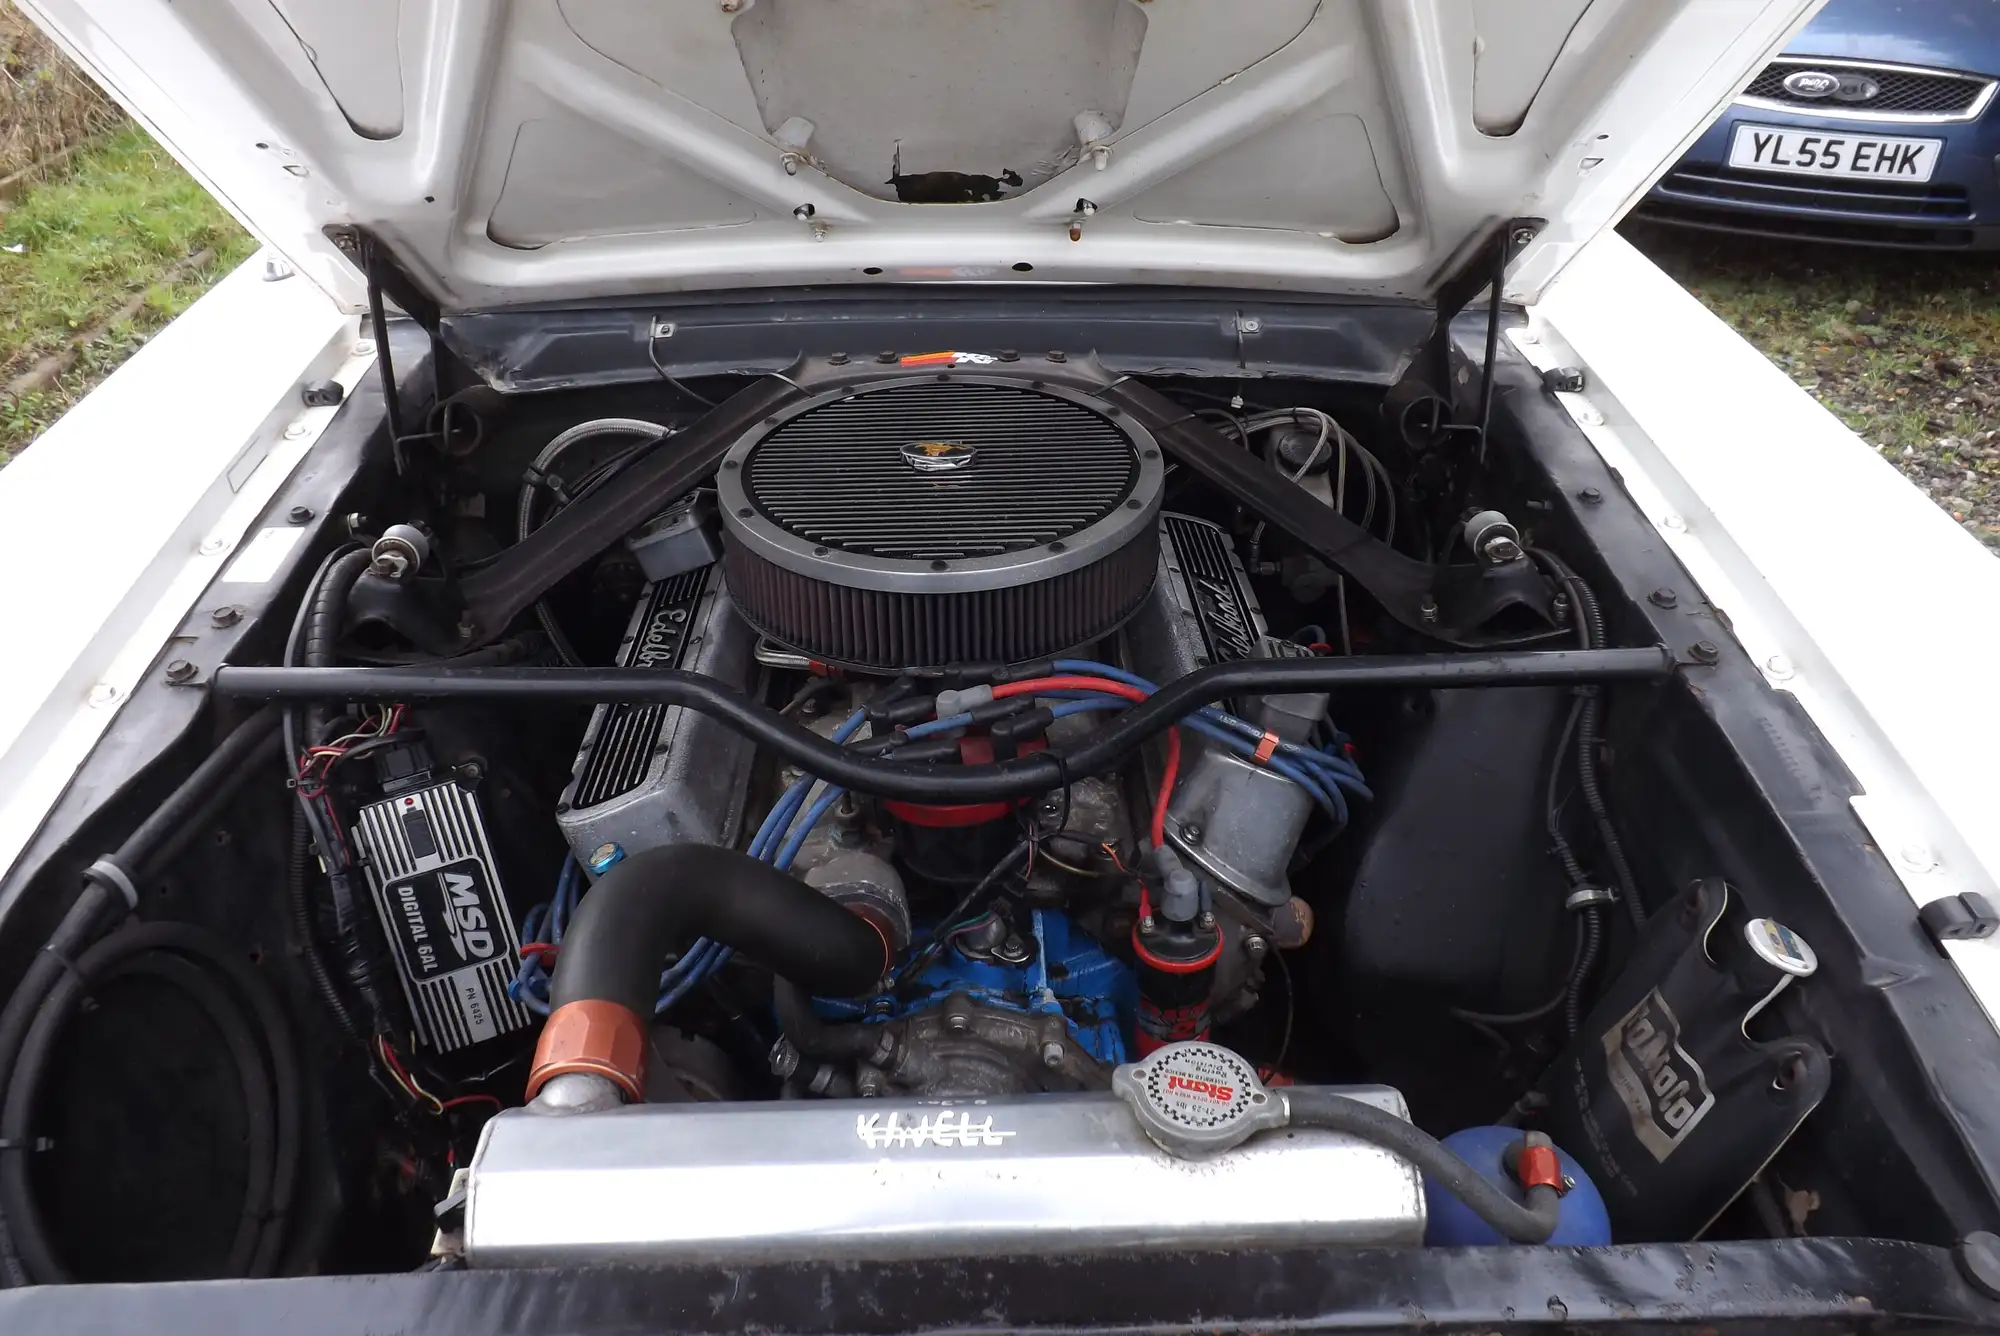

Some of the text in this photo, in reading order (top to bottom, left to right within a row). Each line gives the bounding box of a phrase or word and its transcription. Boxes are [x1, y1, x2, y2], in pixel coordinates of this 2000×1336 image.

[1798, 77, 1830, 92] Ford
[1753, 132, 1925, 175] YL55 EHK
[635, 607, 687, 668] Edelbr
[398, 886, 438, 972] DIGITAL 6AL
[444, 872, 495, 959] MSD
[465, 987, 485, 1026] PN 6425
[1185, 1059, 1223, 1071] Division
[1195, 1066, 1228, 1079] Racing
[1168, 1075, 1233, 1100] Stant
